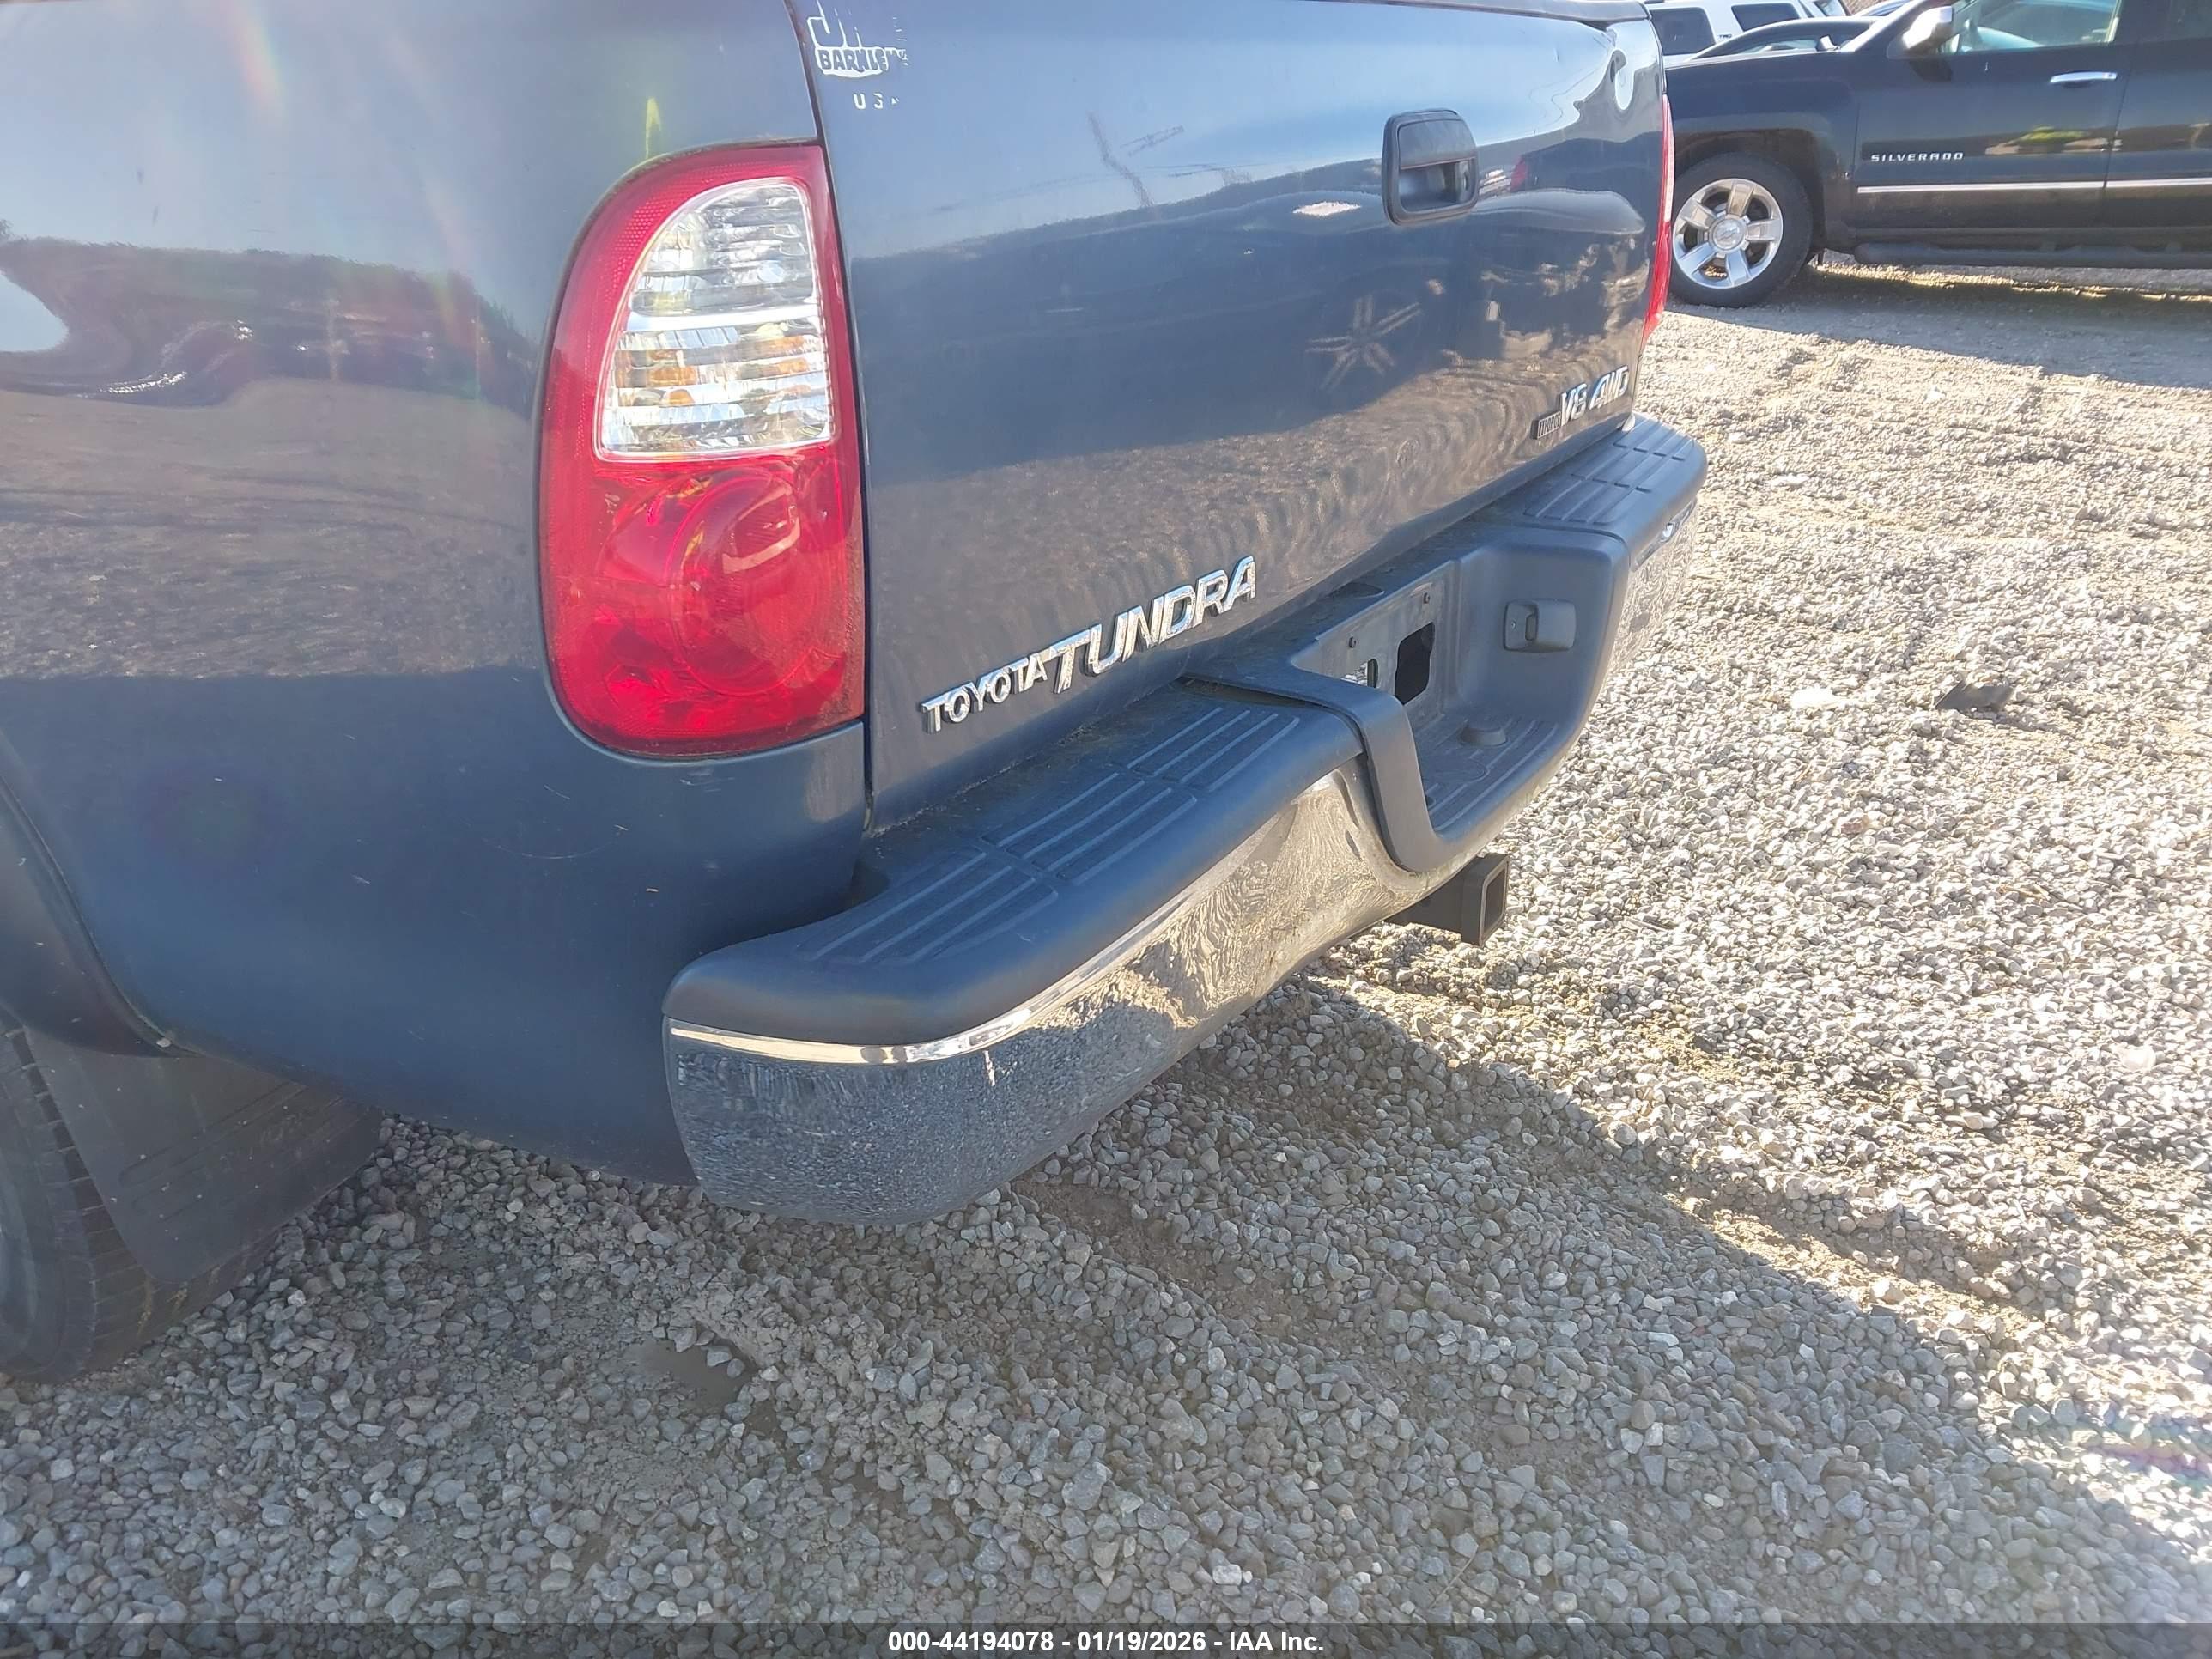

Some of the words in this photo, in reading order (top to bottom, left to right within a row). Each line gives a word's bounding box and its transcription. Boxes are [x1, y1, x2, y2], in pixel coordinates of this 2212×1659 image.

[1870, 152, 1965, 162] SILVERADO
[1561, 383, 1588, 427] V8
[1589, 365, 1629, 410] 4WD
[920, 653, 1048, 734] TOYOTA
[1046, 556, 1257, 695] TUNDRA
